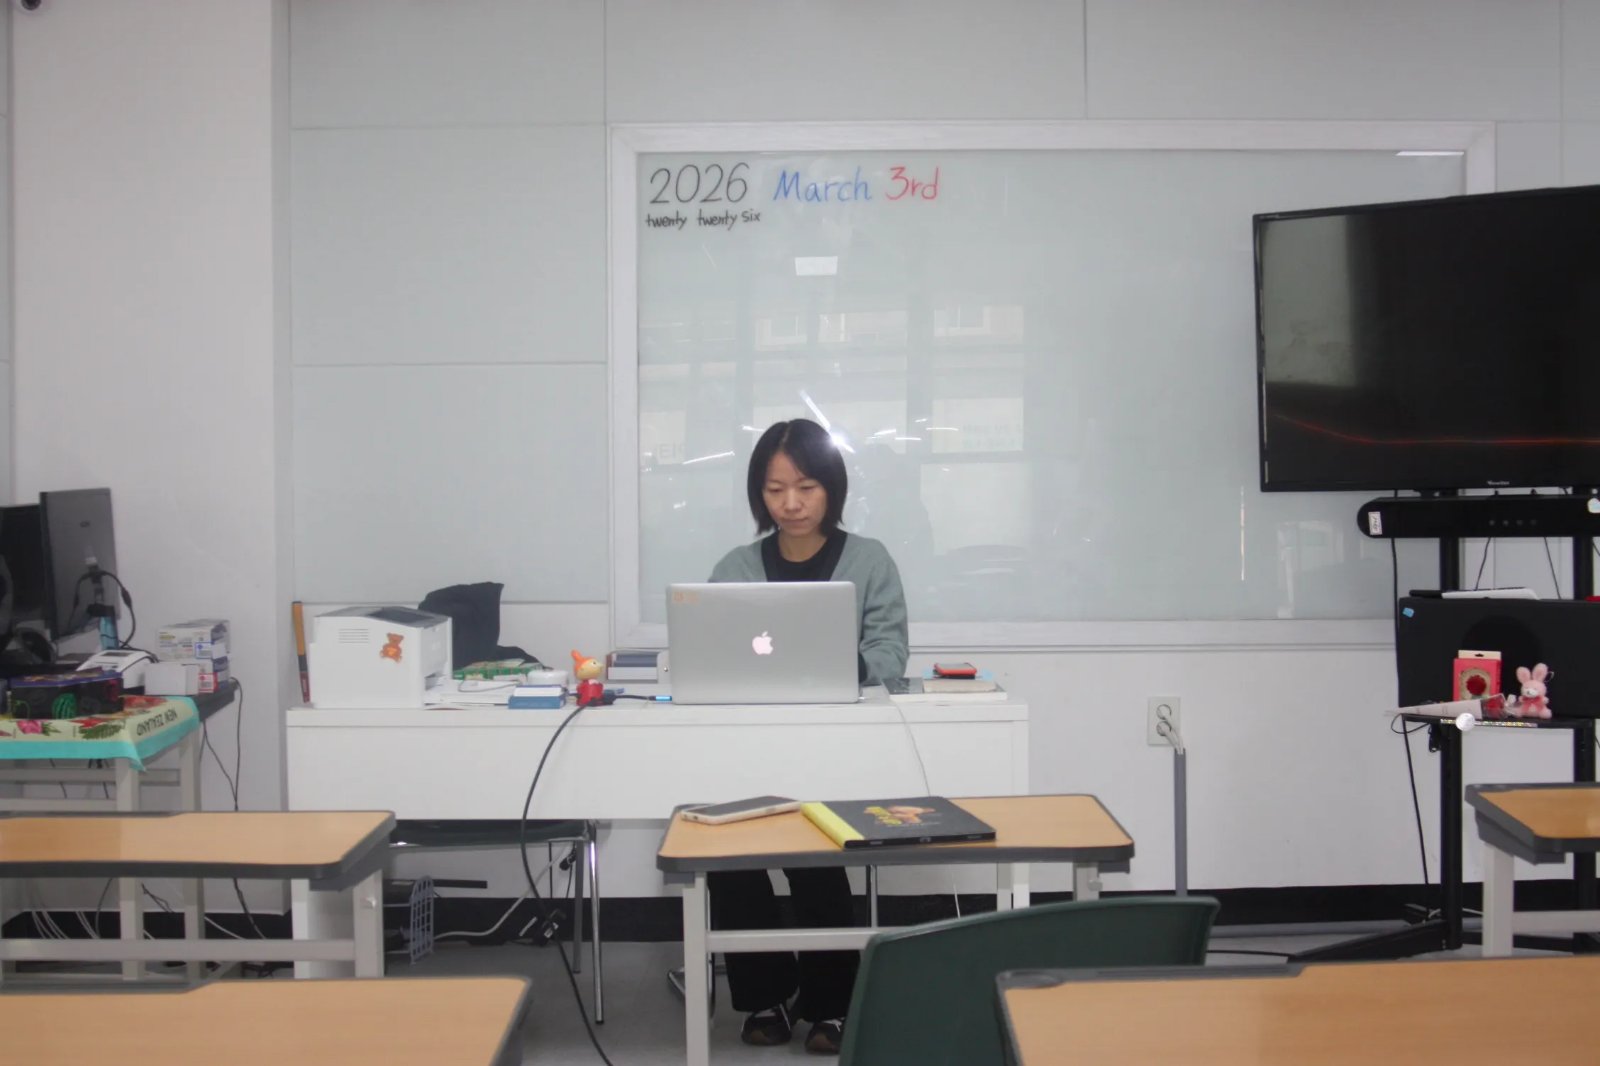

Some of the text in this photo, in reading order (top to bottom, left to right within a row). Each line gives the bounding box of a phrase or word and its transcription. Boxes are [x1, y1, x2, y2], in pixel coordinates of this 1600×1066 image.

[649, 162, 939, 204] 2026 March 3rd
[645, 208, 761, 231] twenty twenty six
